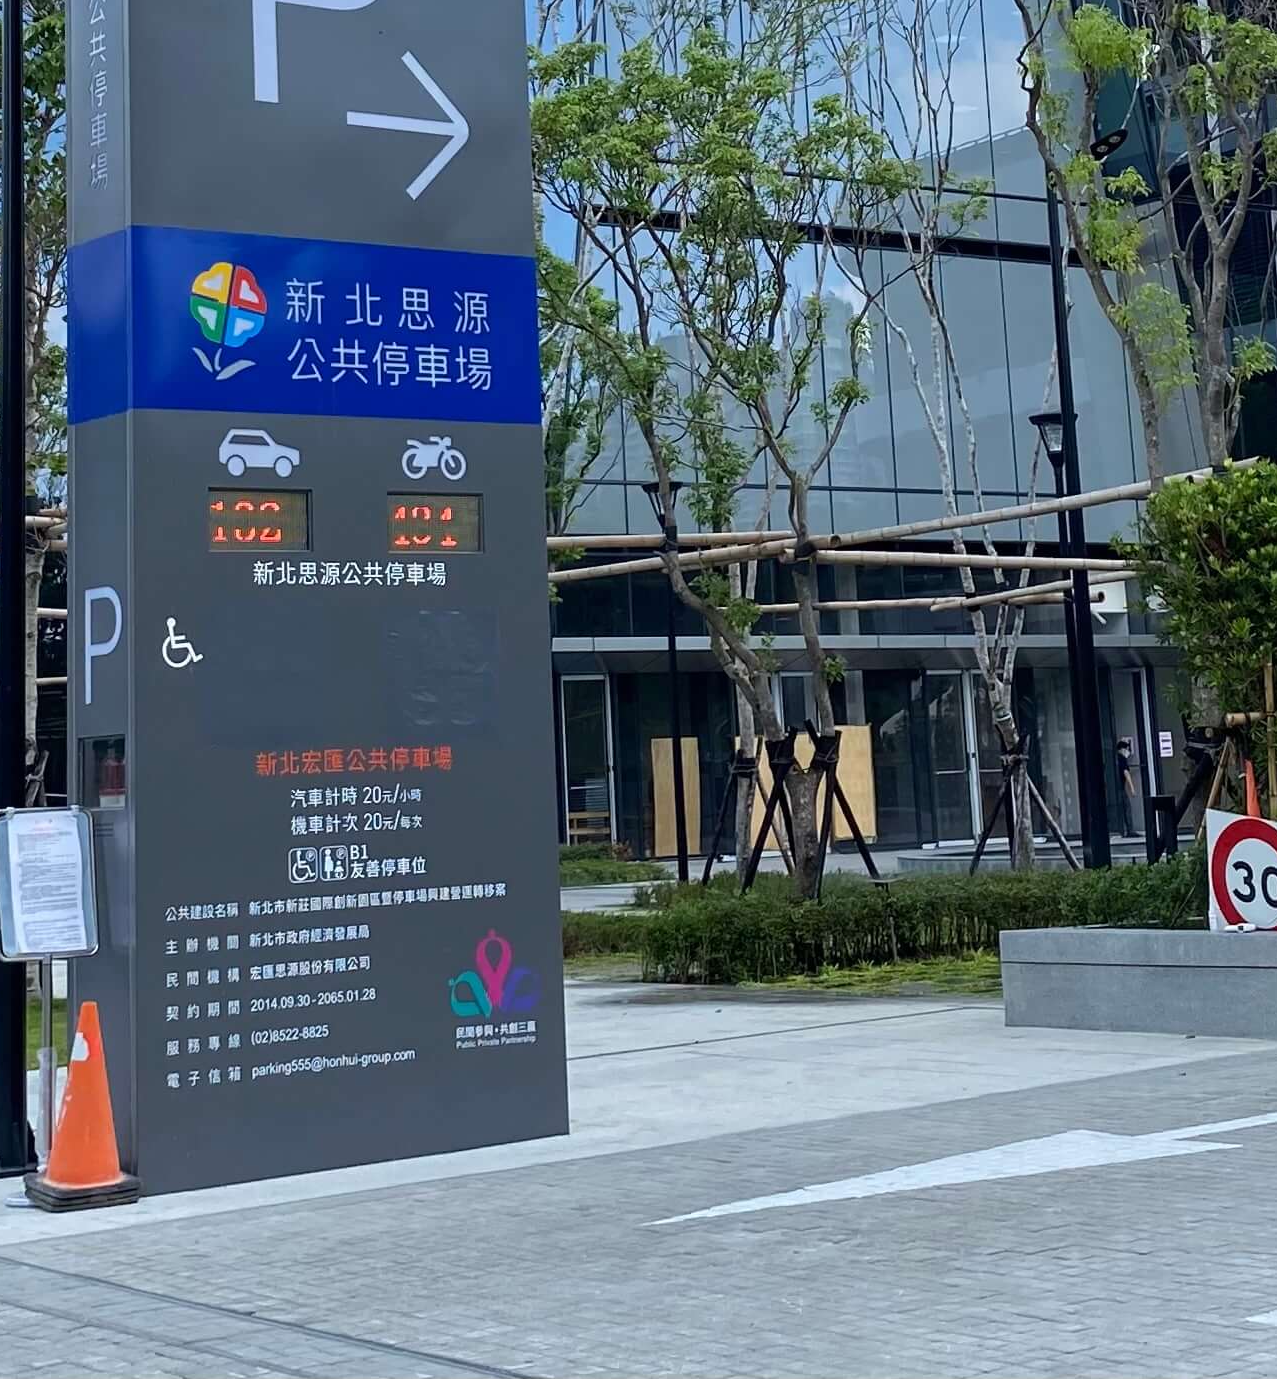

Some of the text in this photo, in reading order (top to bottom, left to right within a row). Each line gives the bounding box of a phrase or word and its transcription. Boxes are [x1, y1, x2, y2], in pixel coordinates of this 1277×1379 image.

[285, 277, 491, 335] 新北思源
[287, 337, 492, 391] 公共停車場
[252, 560, 447, 587] 新北思源公共停車場
[84, 586, 123, 705] P
[257, 745, 452, 775] 新北宏匯公共停車場
[290, 785, 358, 808] 汽車計時
[290, 812, 359, 836] 機車計次
[350, 844, 369, 859] B1
[350, 856, 427, 879] 友善停車位
[164, 902, 239, 922] 公共建設名稱
[249, 955, 371, 981] 宏匯思源股份有限公司
[250, 1024, 330, 1046] (02)8522-8825
[251, 1049, 416, 1080] parking555@honhui-group.com
